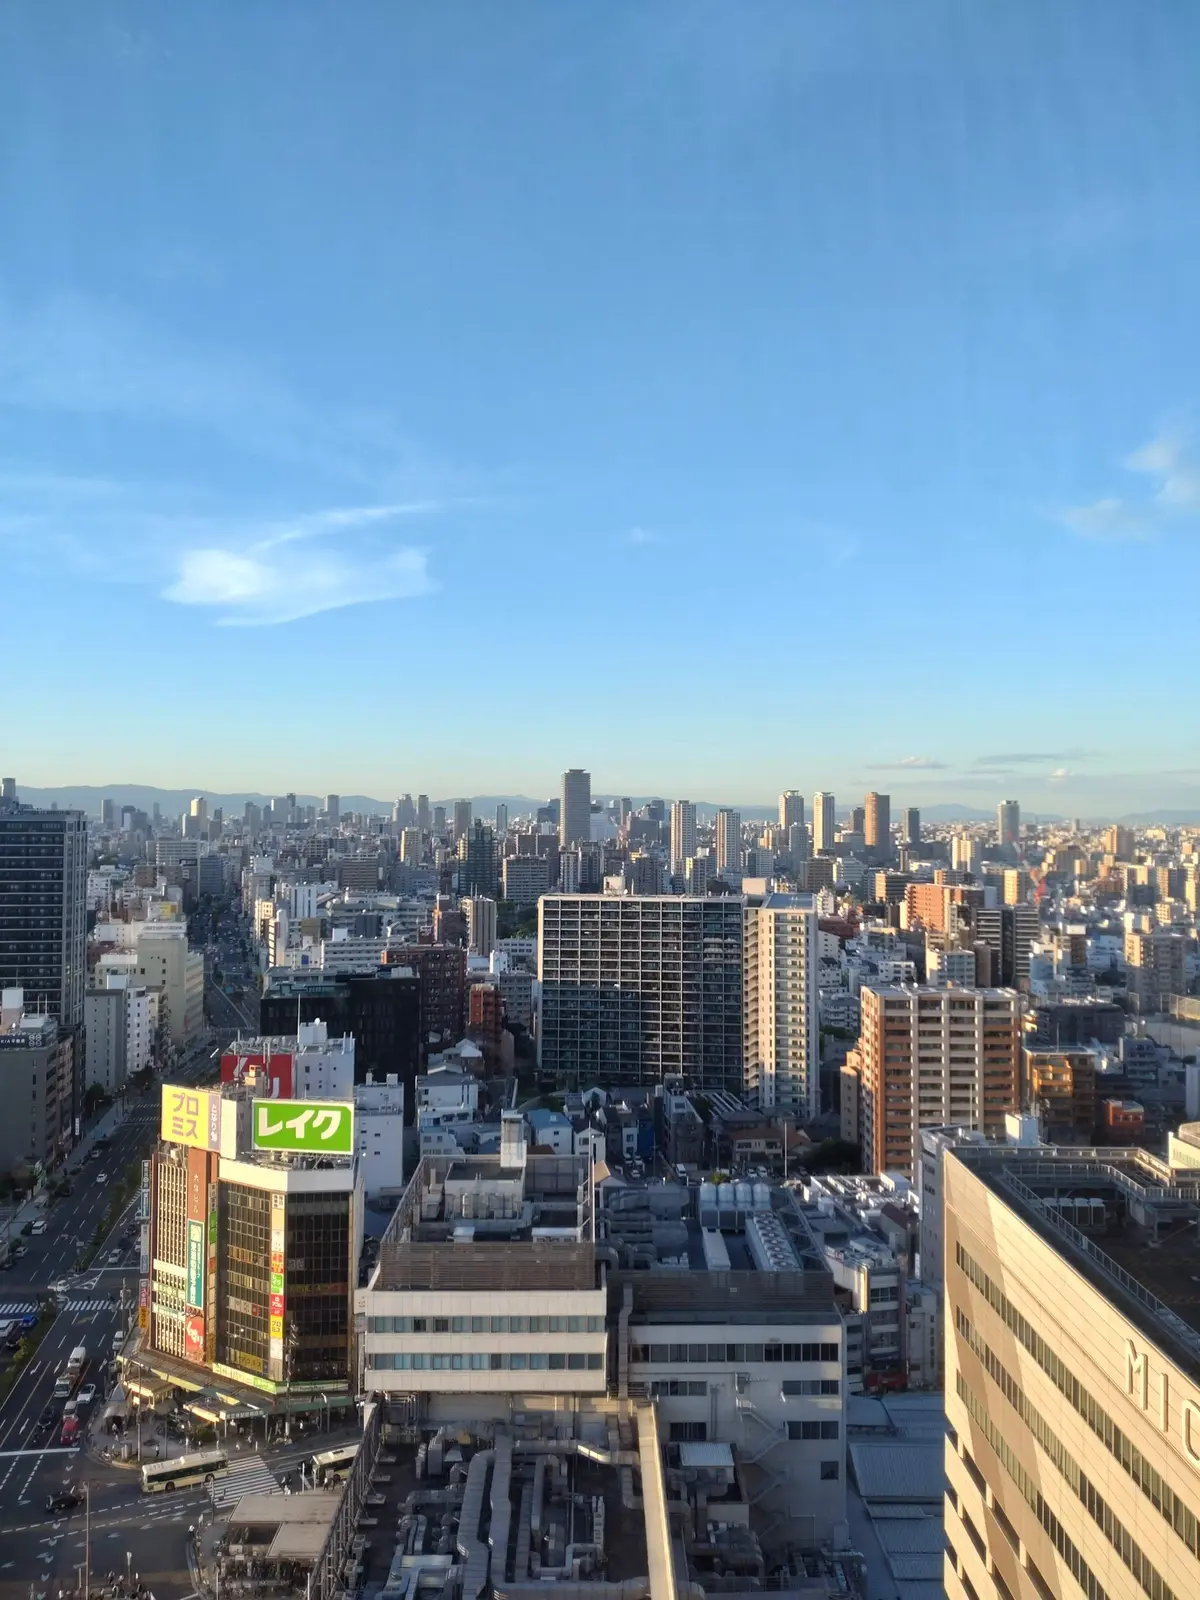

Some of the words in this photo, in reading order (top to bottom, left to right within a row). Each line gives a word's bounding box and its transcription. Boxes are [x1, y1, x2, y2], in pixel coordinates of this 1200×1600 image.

[172, 1092, 198, 1116] プロ
[172, 1116, 198, 1139] ミス
[258, 1107, 342, 1140] レイク
